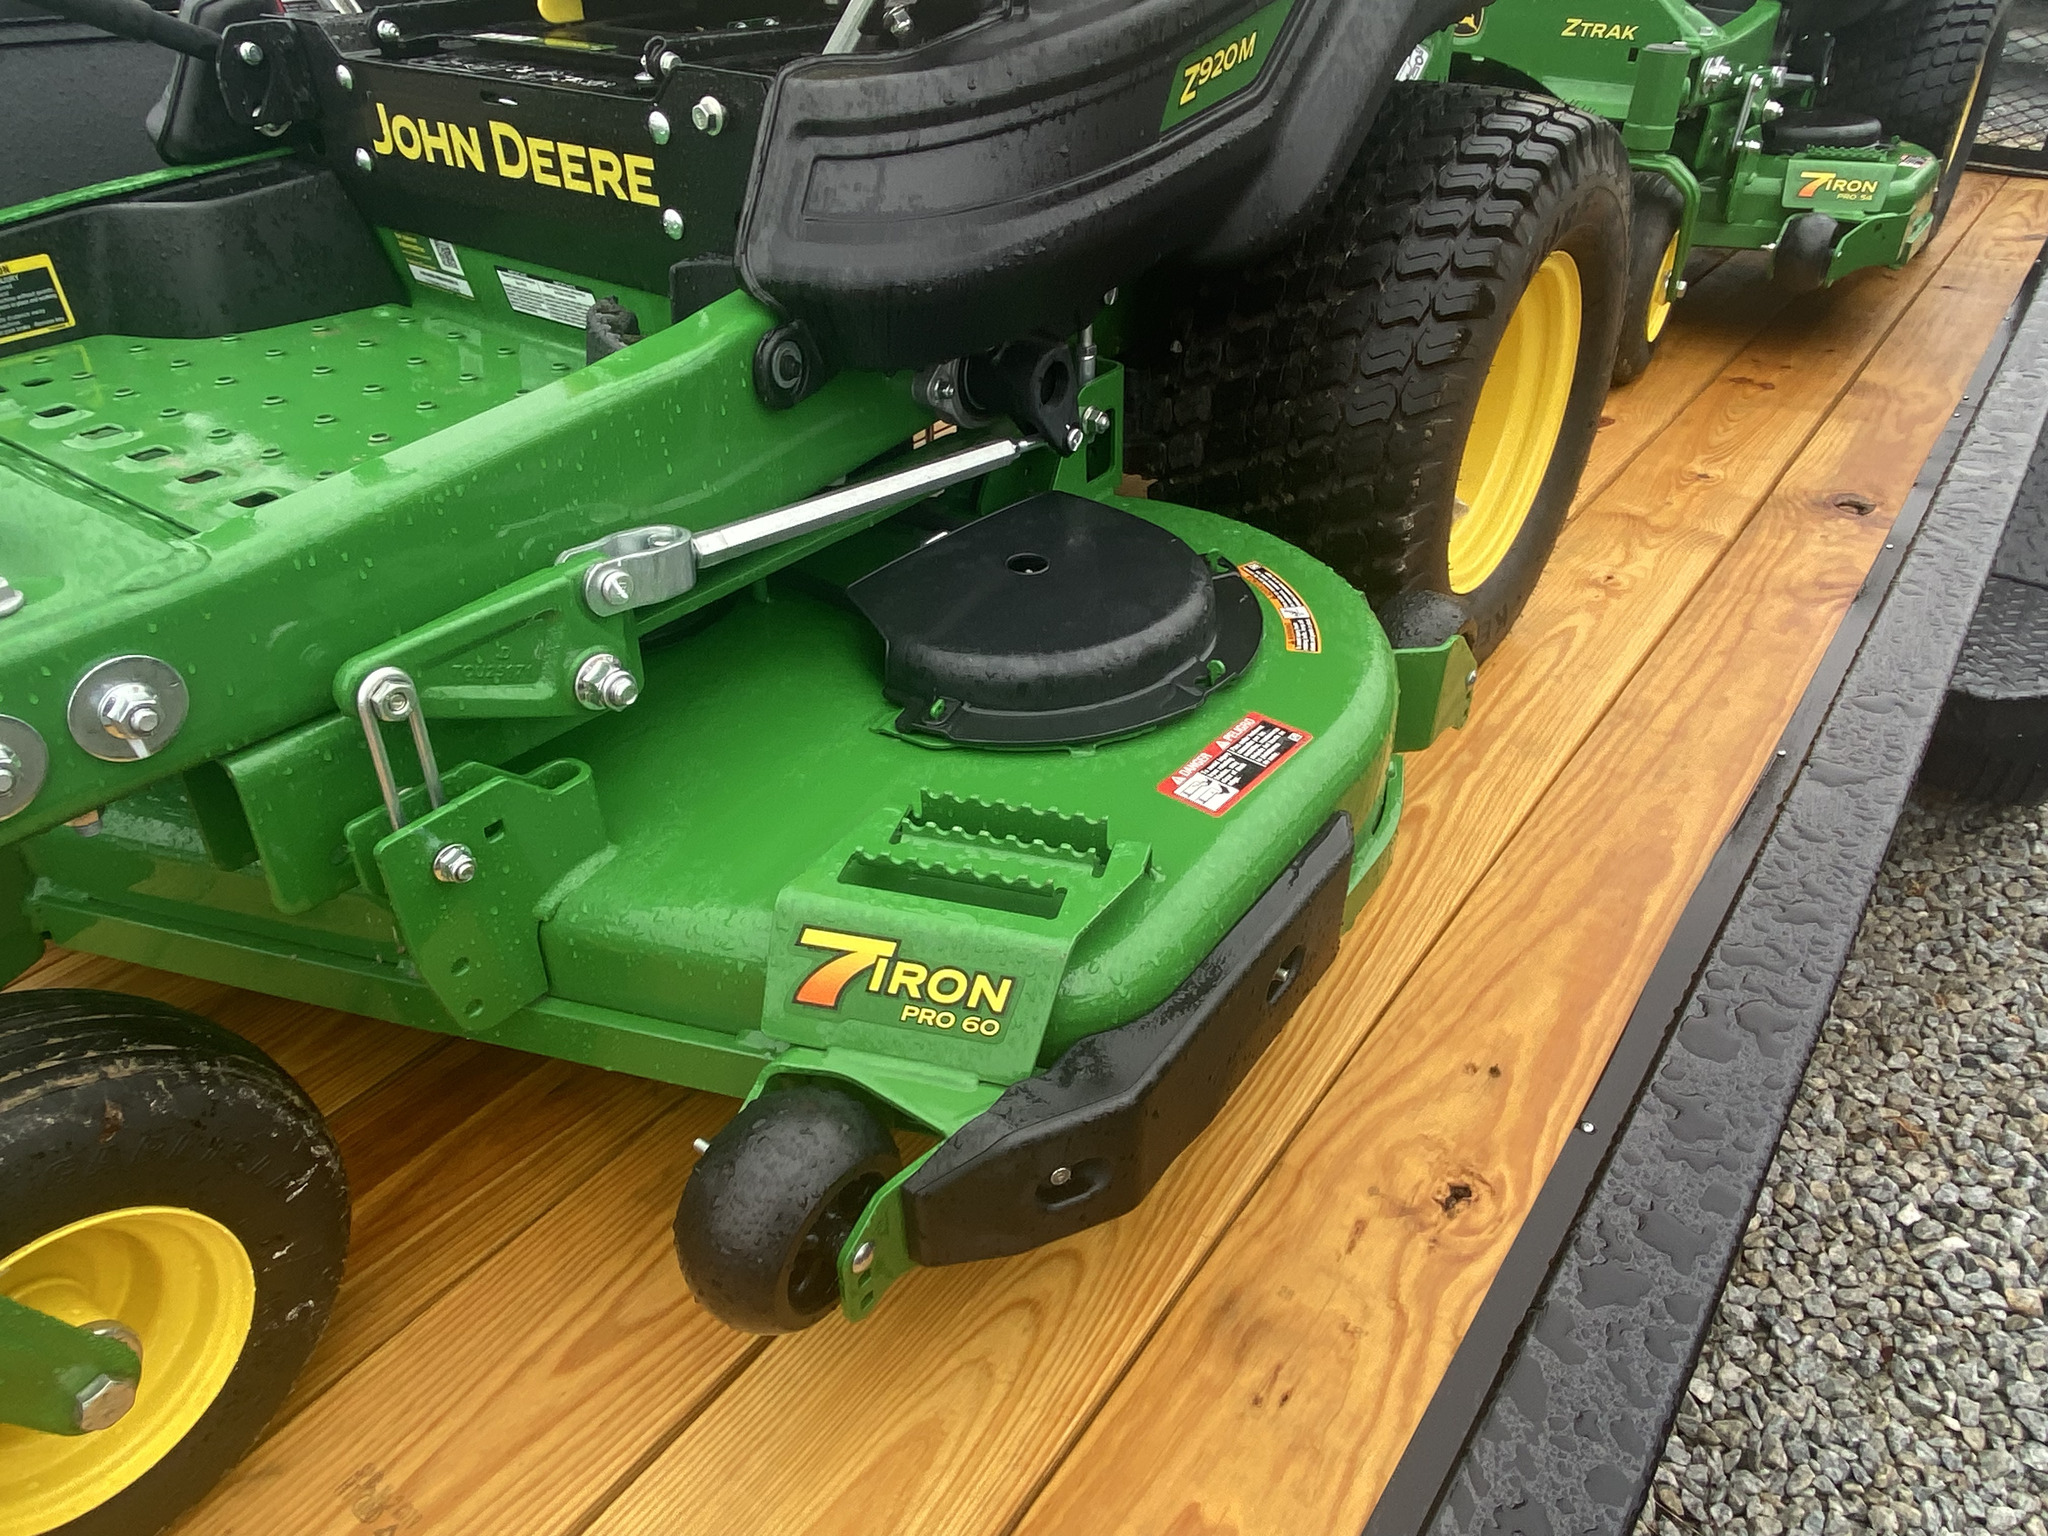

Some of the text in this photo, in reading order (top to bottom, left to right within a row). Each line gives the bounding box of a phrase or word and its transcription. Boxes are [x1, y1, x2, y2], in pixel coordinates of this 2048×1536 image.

[1561, 17, 1639, 41] ZTRAK
[1179, 31, 1257, 106] Z920M
[372, 102, 661, 207] JOHN DEERE
[1836, 193, 1873, 201] PRO 54
[1179, 752, 1213, 778] DANGER
[1223, 717, 1256, 743] PELIGRO
[900, 1004, 1001, 1037] PRO 60
